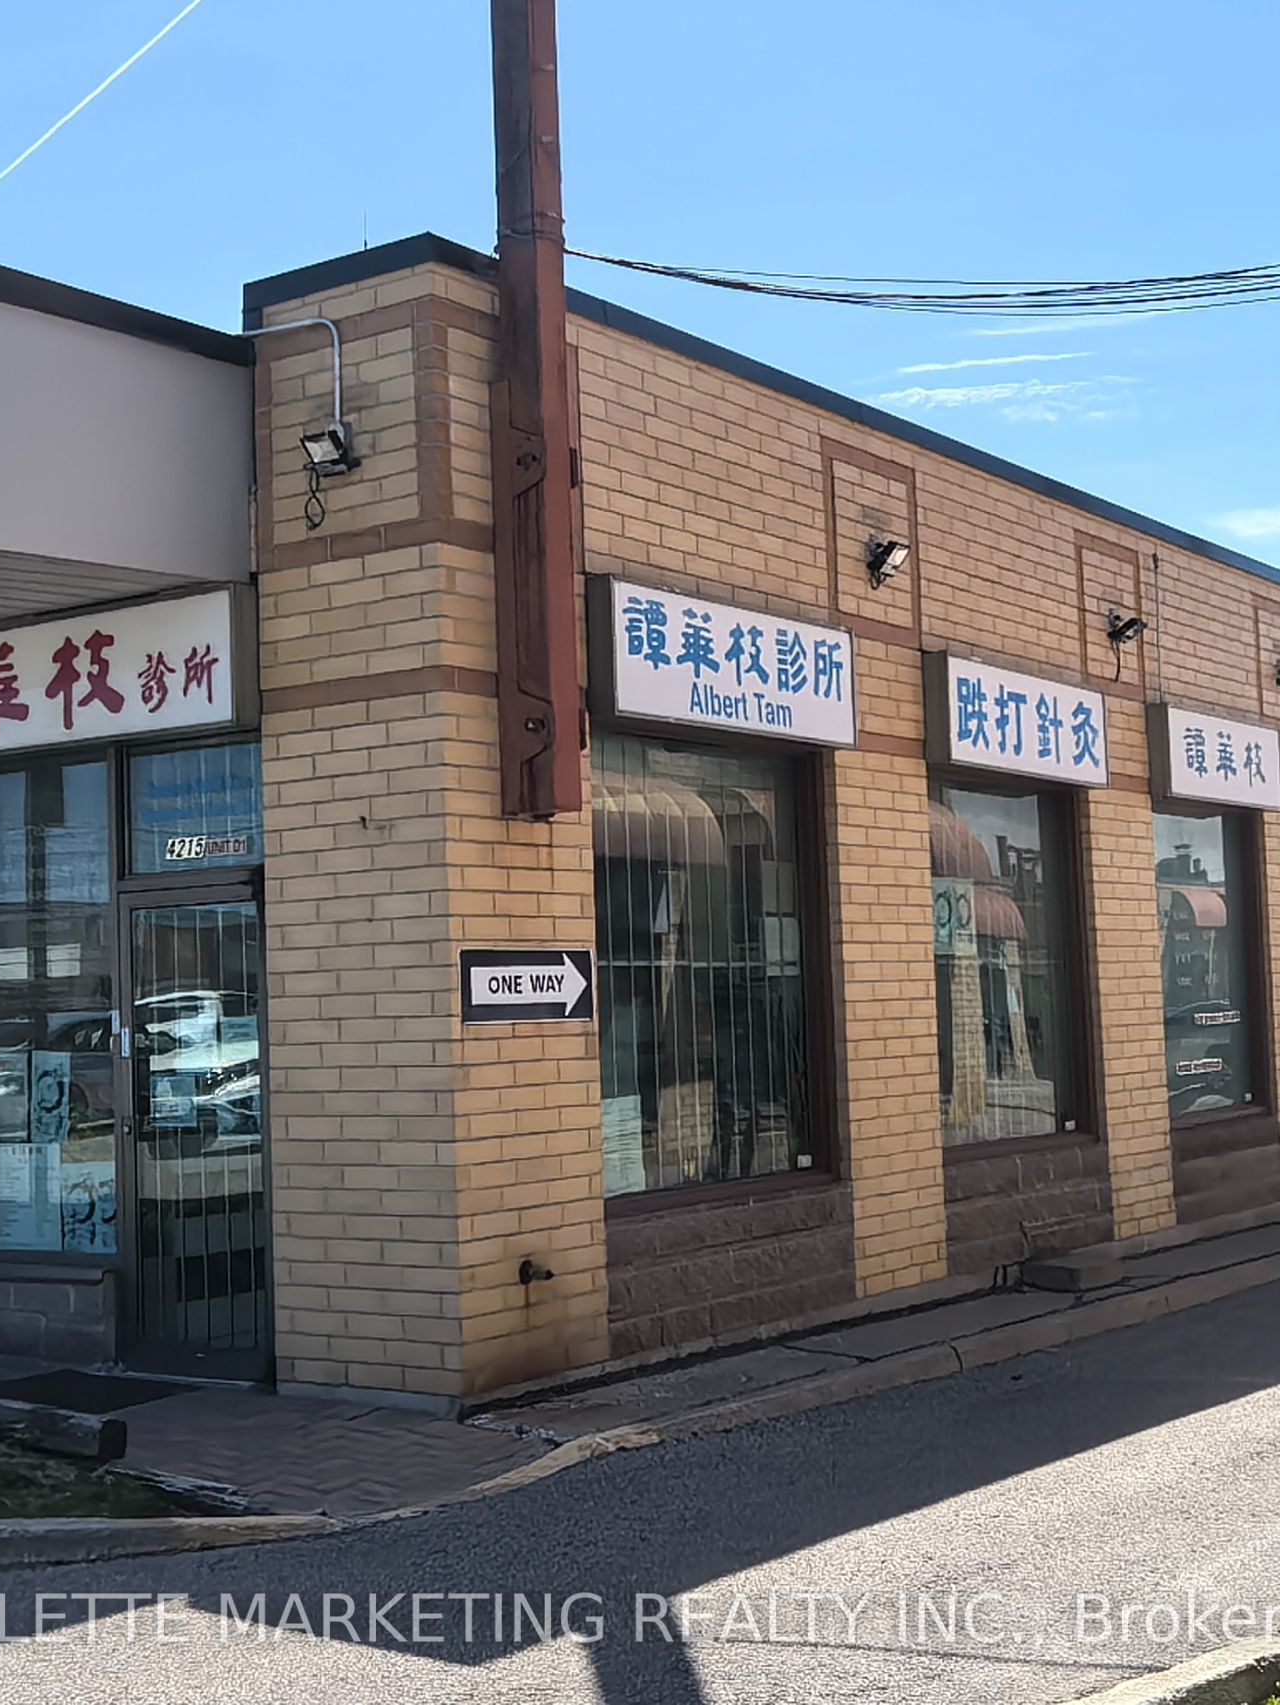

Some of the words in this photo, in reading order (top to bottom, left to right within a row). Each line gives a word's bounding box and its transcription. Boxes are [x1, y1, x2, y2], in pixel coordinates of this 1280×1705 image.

[690, 682, 749, 721] Albert
[753, 693, 793, 728] Tam
[957, 677, 1100, 768] 跌打針灸
[166, 837, 206, 859] 4215
[488, 975, 523, 994] ONE
[530, 974, 564, 993] WAY
